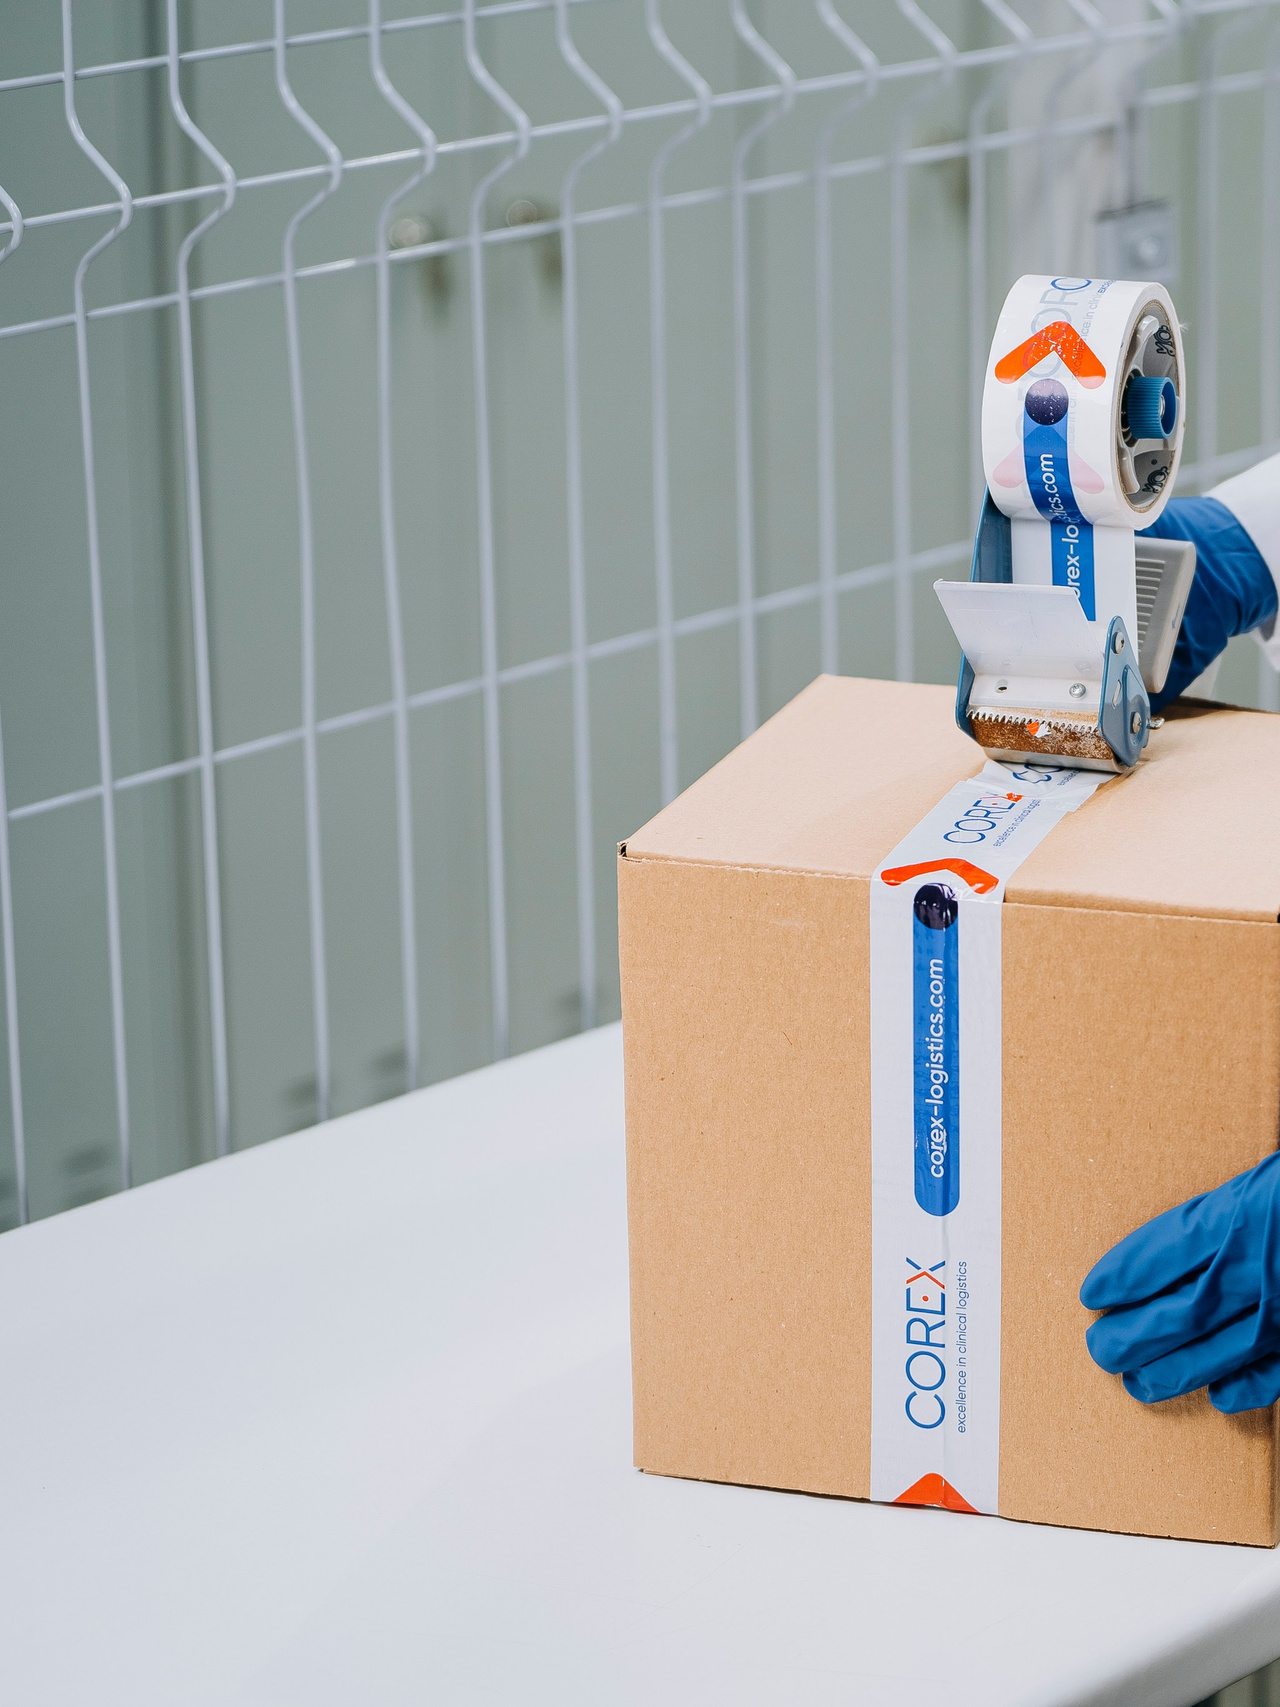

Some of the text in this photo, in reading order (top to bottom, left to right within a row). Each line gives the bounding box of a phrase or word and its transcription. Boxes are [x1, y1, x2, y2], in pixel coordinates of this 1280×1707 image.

[925, 958, 949, 1179] corex-logistics.com
[905, 1256, 946, 1429] COREX
[956, 1261, 970, 1434] excellence in clinical logistics
